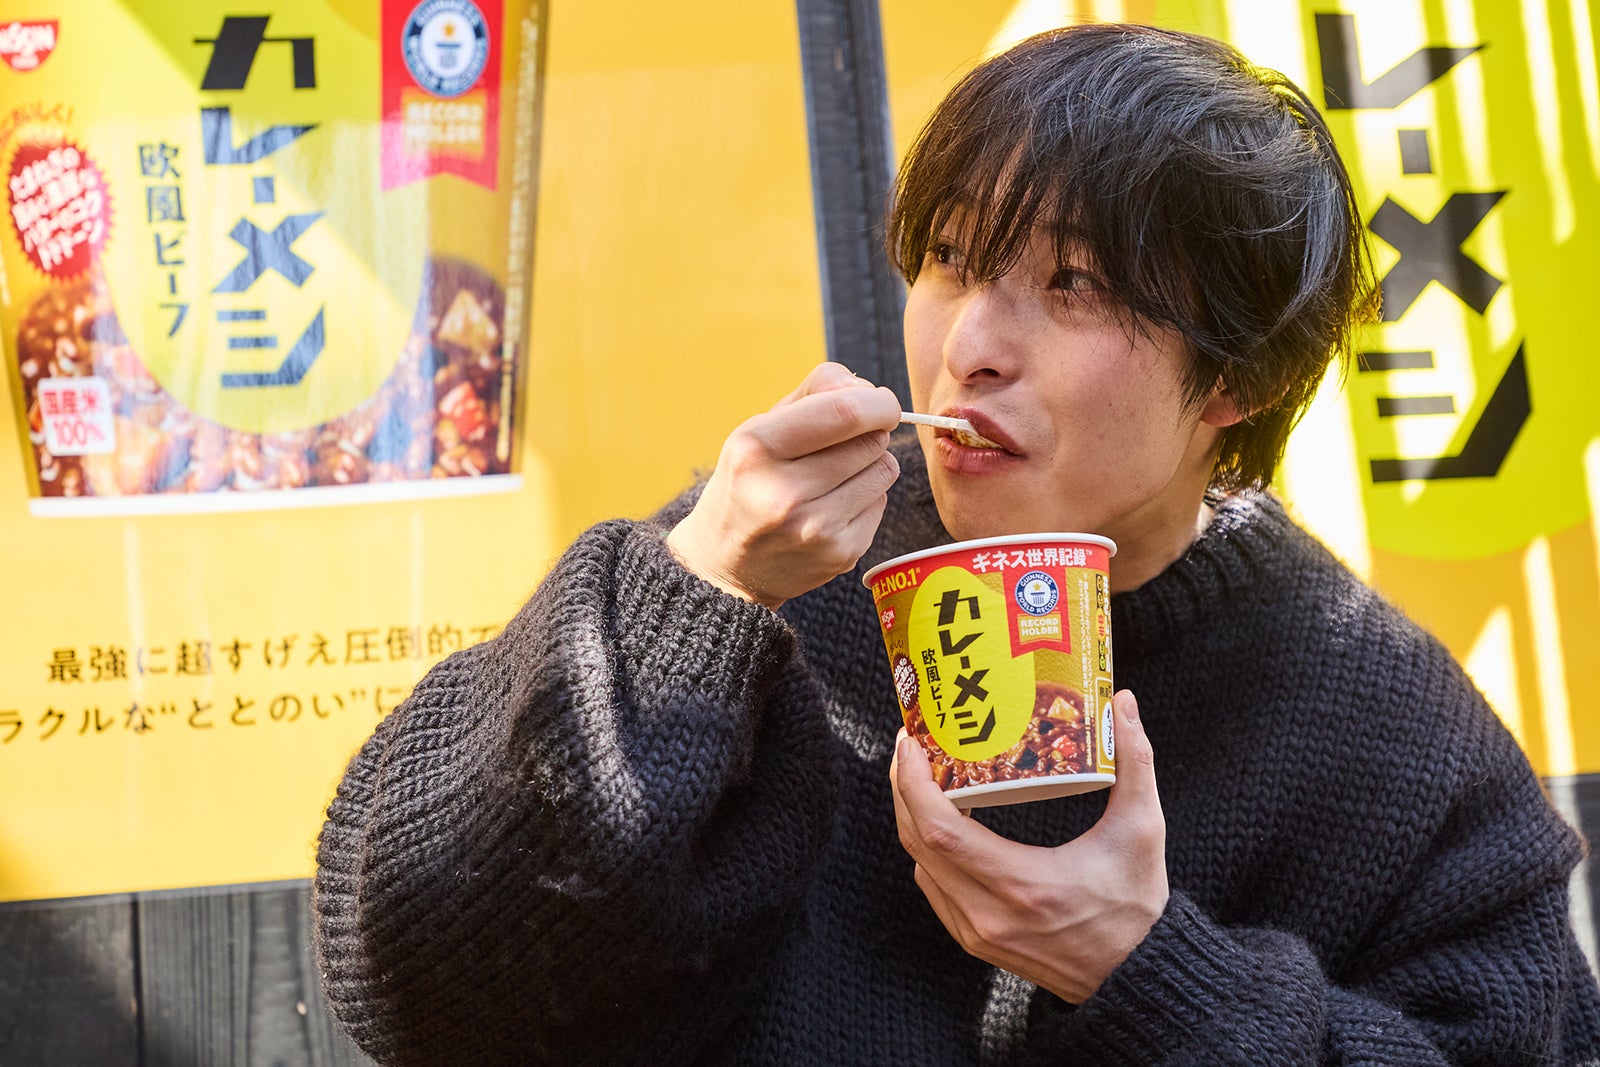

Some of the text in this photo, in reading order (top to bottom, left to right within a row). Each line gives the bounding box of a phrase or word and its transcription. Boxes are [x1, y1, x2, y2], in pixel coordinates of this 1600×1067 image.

[192, 14, 326, 389] カレーメシ
[139, 142, 190, 339] 欧風ビーフ
[1017, 589, 1058, 614] WORLD RECORDS
[1020, 573, 1053, 587] GUINNESS
[1020, 617, 1060, 628] RECORD
[1021, 626, 1060, 637] HOLDER
[921, 648, 947, 729] 欧風ビーフ
[933, 589, 997, 747] カレーメシ
